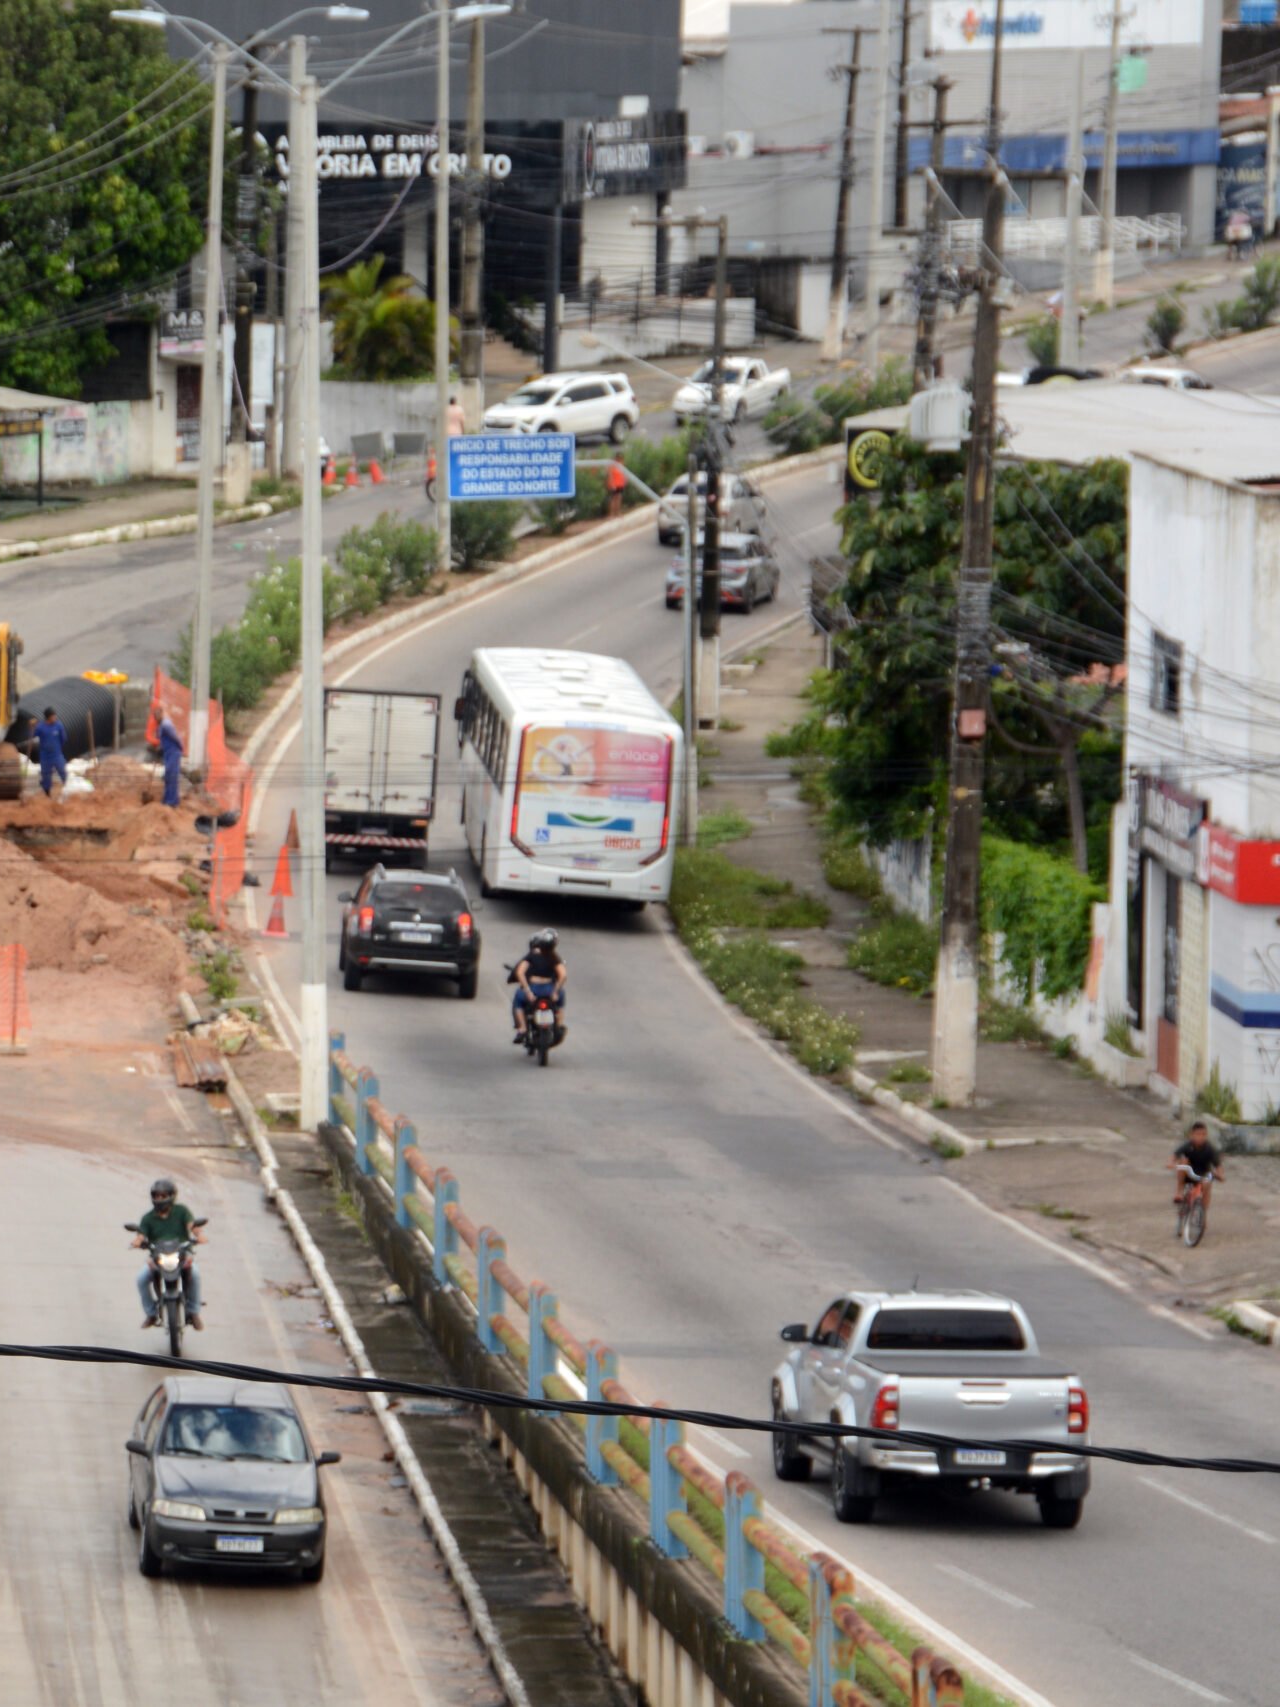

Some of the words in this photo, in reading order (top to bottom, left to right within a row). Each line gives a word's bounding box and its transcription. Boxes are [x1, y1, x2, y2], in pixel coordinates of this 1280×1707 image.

[276, 134, 366, 151] AMBLEIA
[372, 134, 394, 150] DE
[399, 134, 439, 150] DEUS
[276, 151, 377, 178] VÓRIA
[382, 153, 421, 177] EM
[429, 153, 512, 178] CRITO
[486, 440, 500, 450] DE
[504, 438, 545, 450] TRECHO
[547, 438, 570, 449] SOB
[459, 452, 563, 465] RESPONSABILIDADE
[462, 468, 478, 479] DO
[480, 467, 522, 478] ESTADO
[524, 467, 540, 477] DO
[542, 466, 560, 477] RIO
[462, 481, 506, 493] GRANDE
[508, 481, 524, 492] DO
[525, 480, 560, 491] NORTE
[609, 750, 659, 762] enlace
